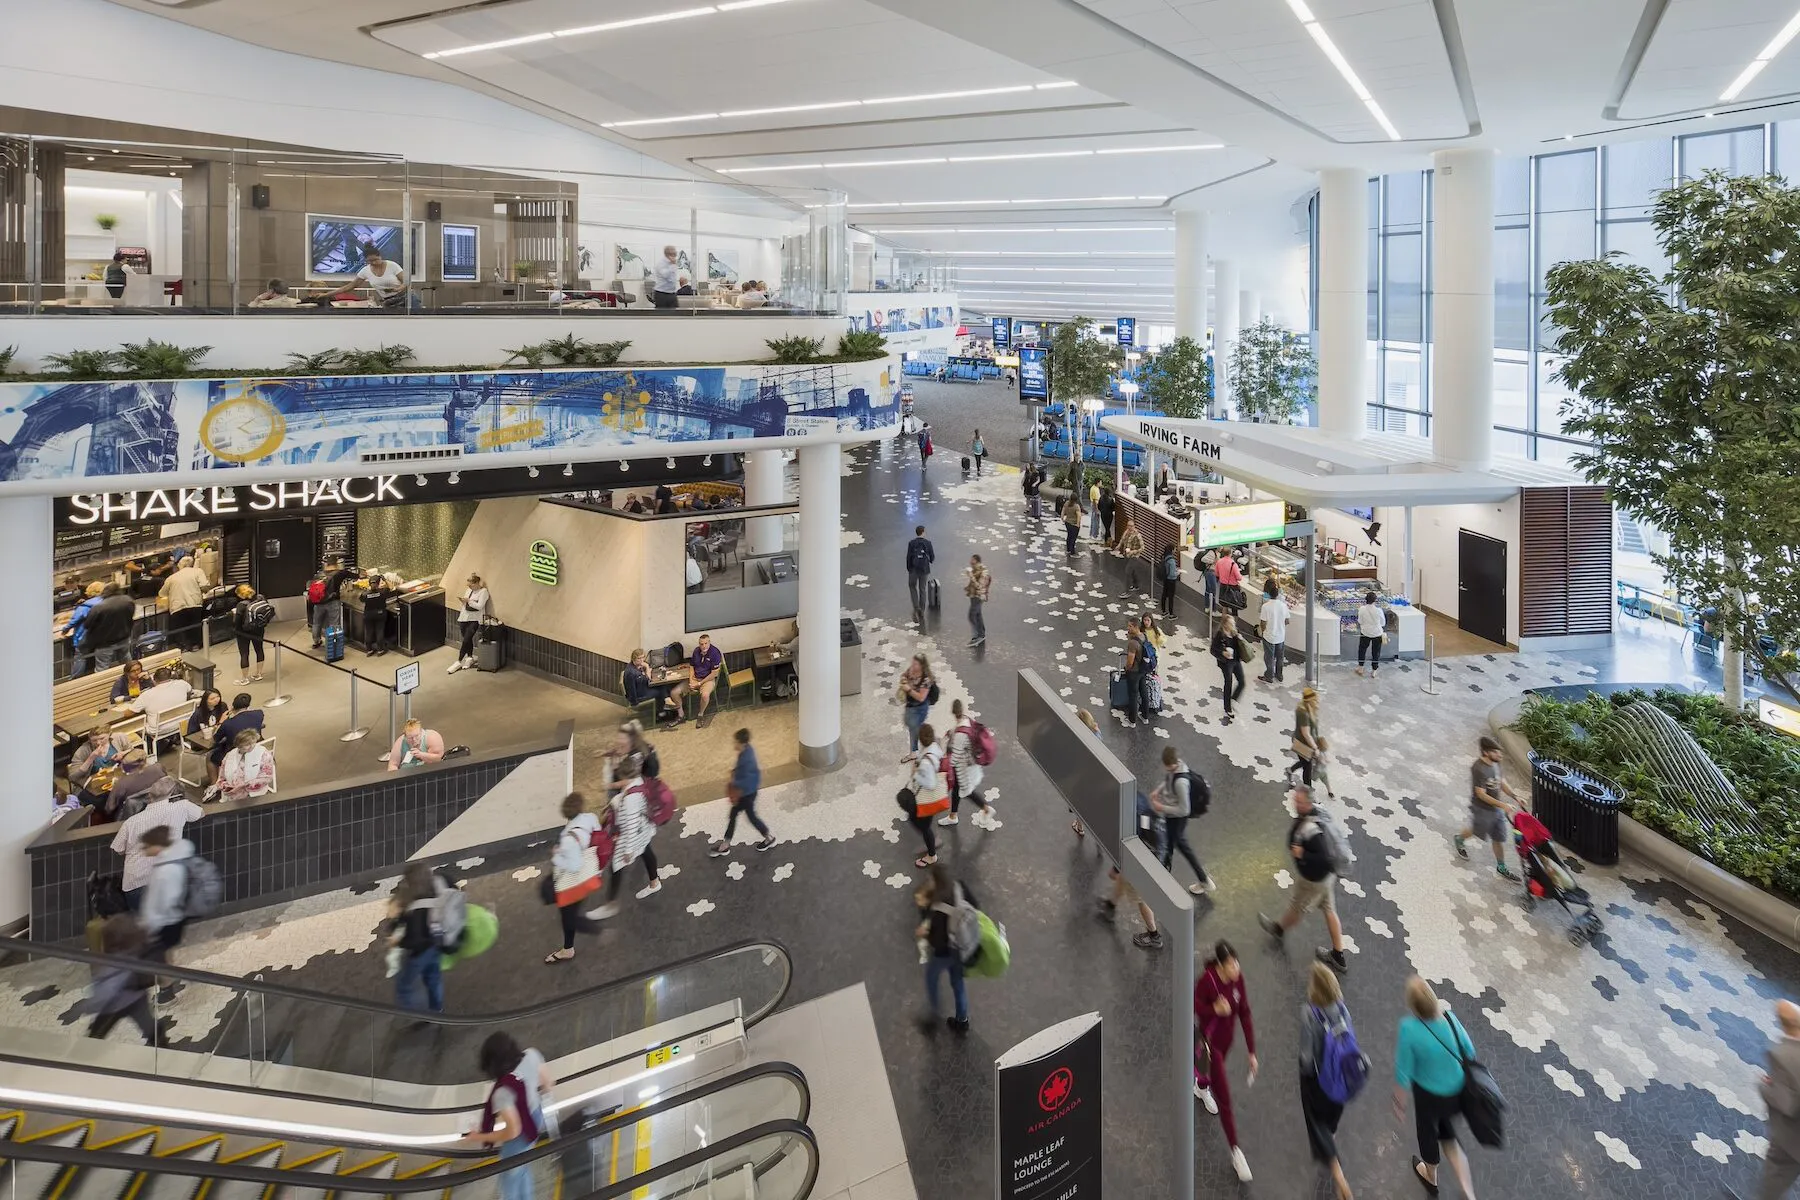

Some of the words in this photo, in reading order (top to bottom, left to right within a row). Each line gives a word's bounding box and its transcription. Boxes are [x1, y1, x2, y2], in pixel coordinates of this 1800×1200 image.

[1140, 422, 1178, 445] IRVING
[1183, 436, 1221, 460] FARM
[1145, 443, 1171, 458] COFFEE
[68, 486, 239, 524] SHAKE
[248, 474, 404, 511] SHACK
[1028, 1120, 1044, 1133] AIR
[1046, 1097, 1082, 1125] CANADA
[1014, 1149, 1043, 1168] MAPLE
[1045, 1136, 1065, 1155] LEAF
[1014, 1156, 1053, 1181] LOUNGE
